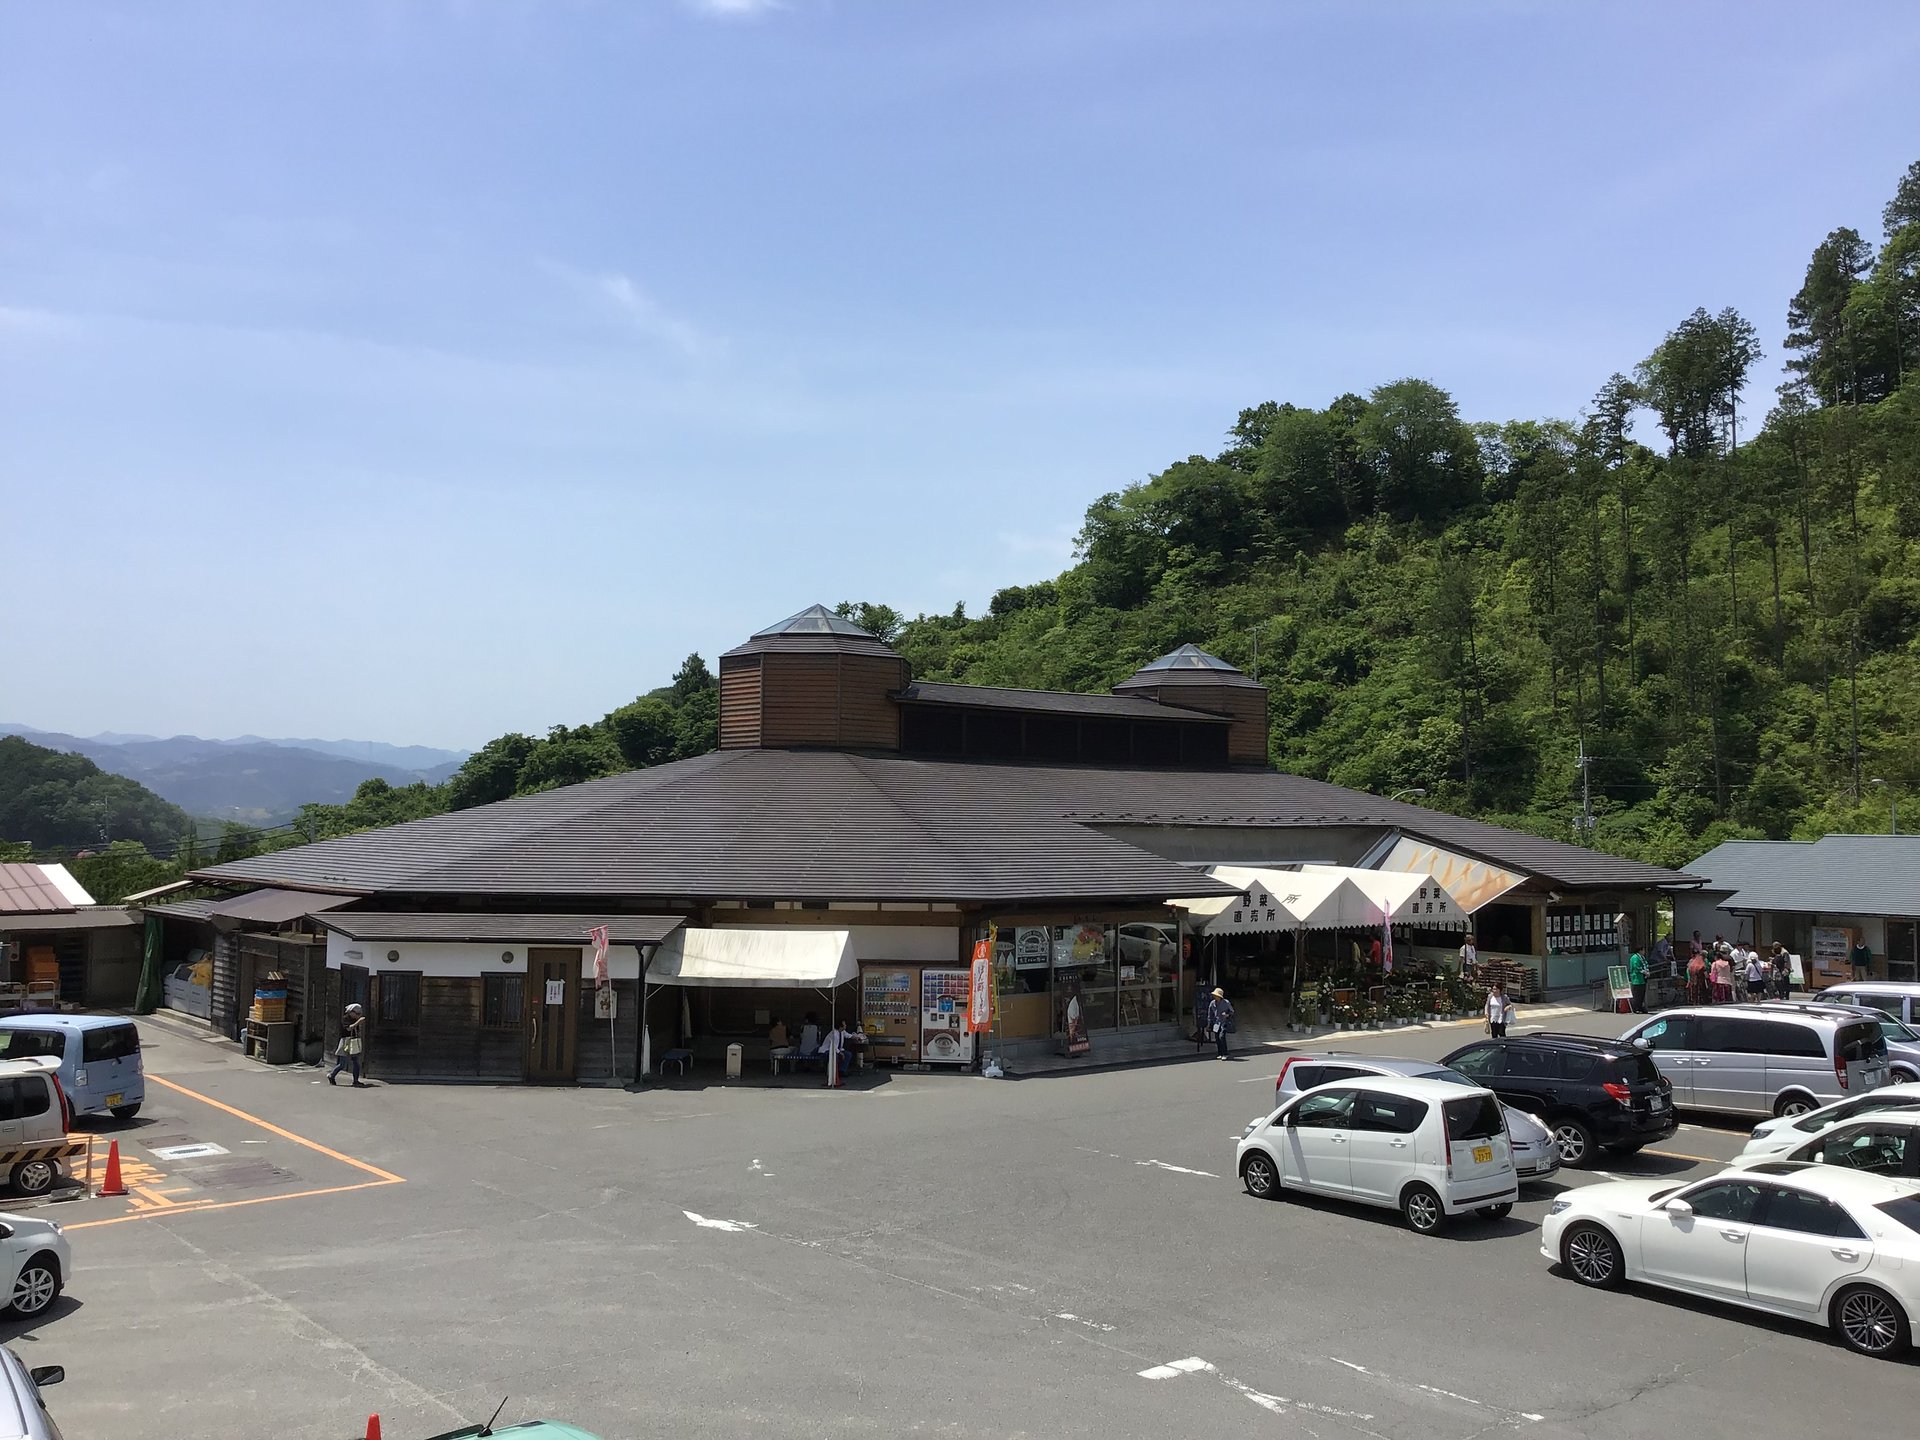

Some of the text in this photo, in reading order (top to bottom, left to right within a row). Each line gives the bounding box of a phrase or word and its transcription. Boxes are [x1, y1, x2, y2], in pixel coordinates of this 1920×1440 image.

[1243, 892, 1268, 907] 野菜
[1420, 887, 1441, 899] 野菜
[1412, 902, 1447, 914] 直売所
[1233, 909, 1276, 923] 直売所
